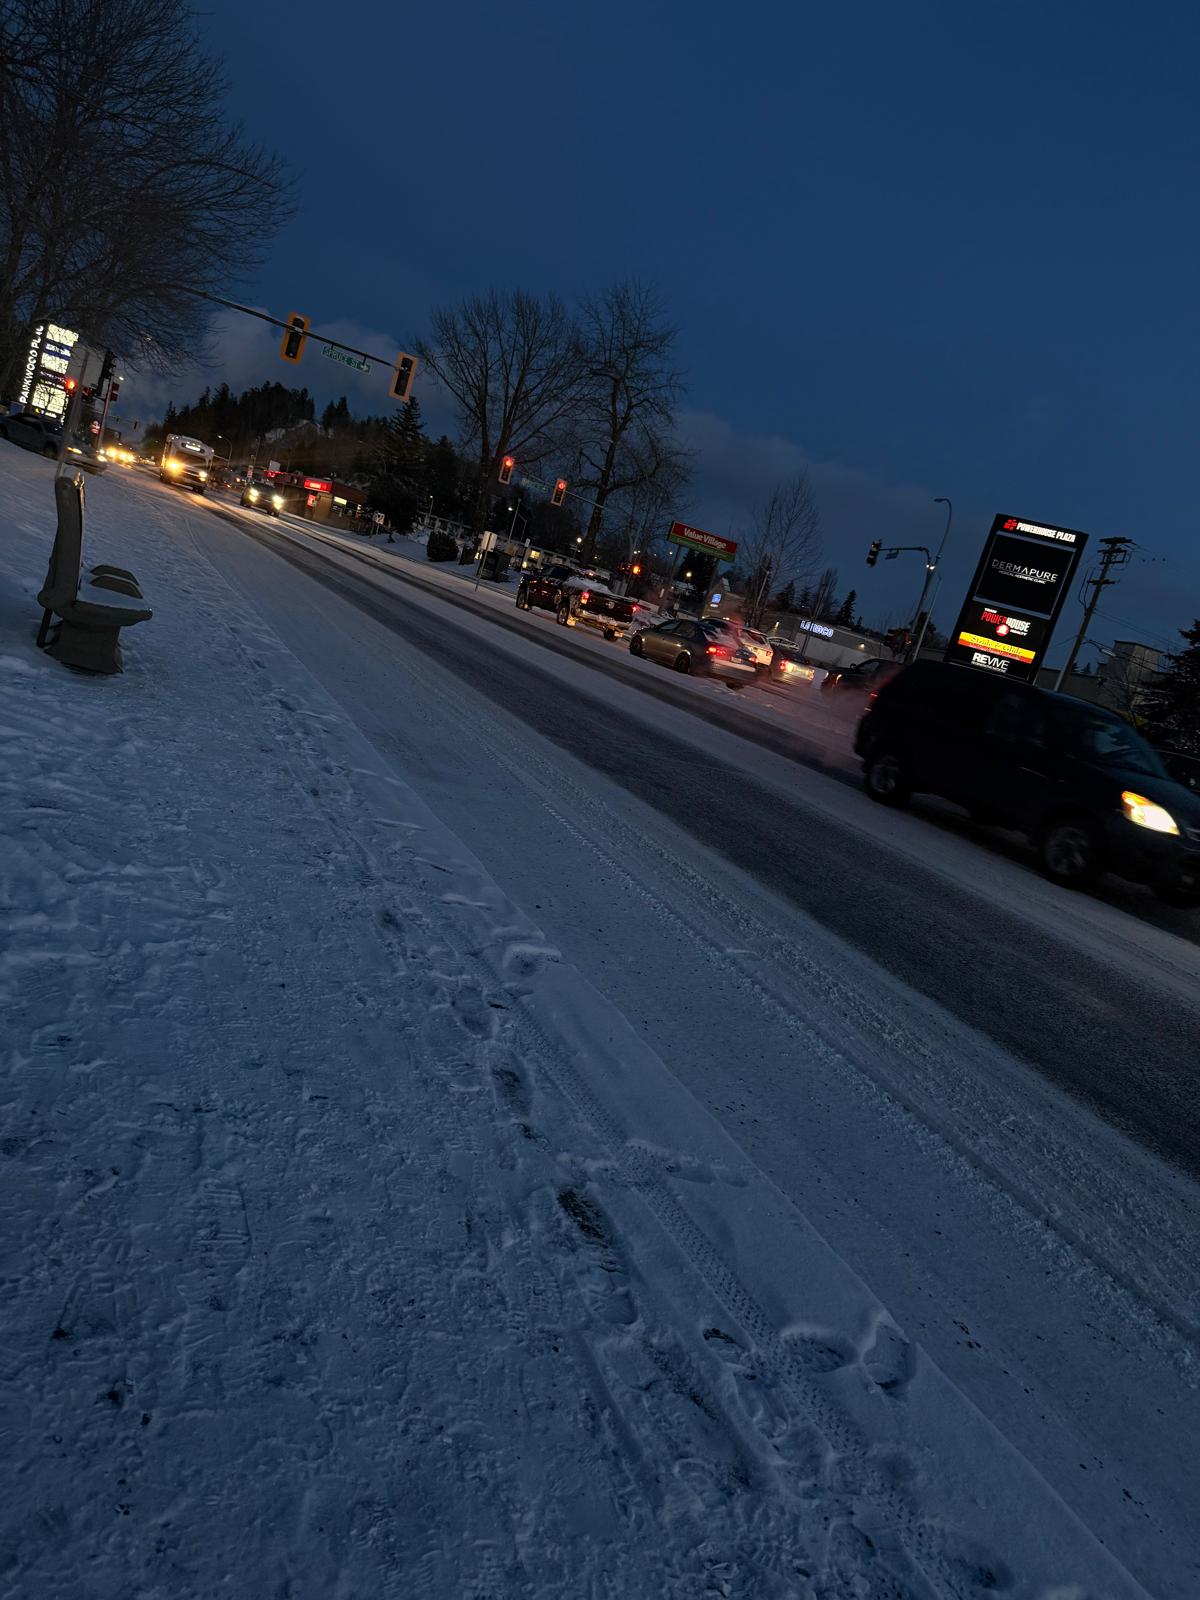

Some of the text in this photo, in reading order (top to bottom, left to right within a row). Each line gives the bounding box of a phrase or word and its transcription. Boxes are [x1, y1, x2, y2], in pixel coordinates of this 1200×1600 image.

[19, 349, 38, 405] PARKWOOD
[684, 527, 704, 541] Value
[702, 534, 727, 550] Village
[1016, 522, 1077, 543] POWERHOUSE PLAZA
[992, 558, 1059, 581] DERMAPURE
[981, 611, 1031, 632] POWERHOUSE
[972, 652, 1011, 670] REVIVE
